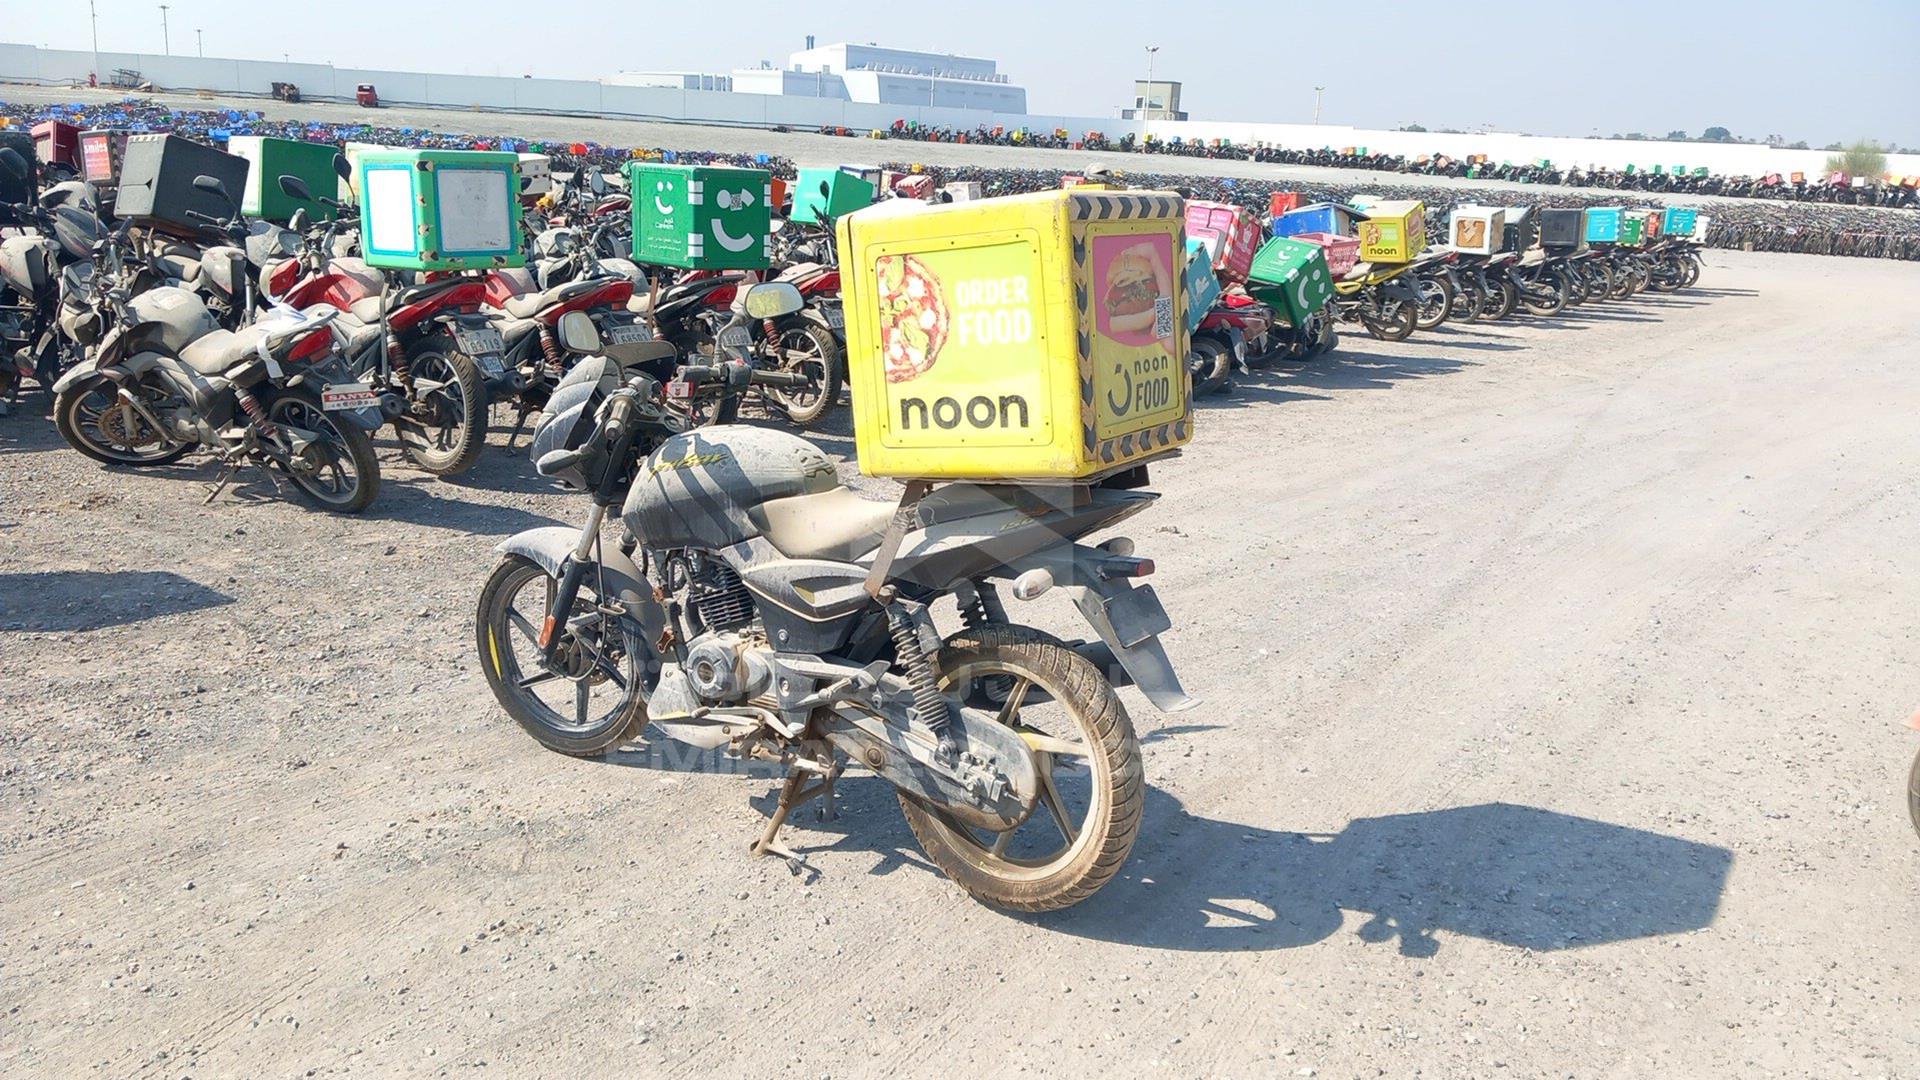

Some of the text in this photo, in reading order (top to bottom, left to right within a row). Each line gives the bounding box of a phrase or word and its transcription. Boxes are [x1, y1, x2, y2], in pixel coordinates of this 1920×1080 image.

[956, 275, 1030, 307] ORDER
[958, 308, 1032, 346] FOOD
[1134, 355, 1169, 375] noon
[1136, 377, 1169, 412] FOOD
[900, 395, 1029, 430] noon
